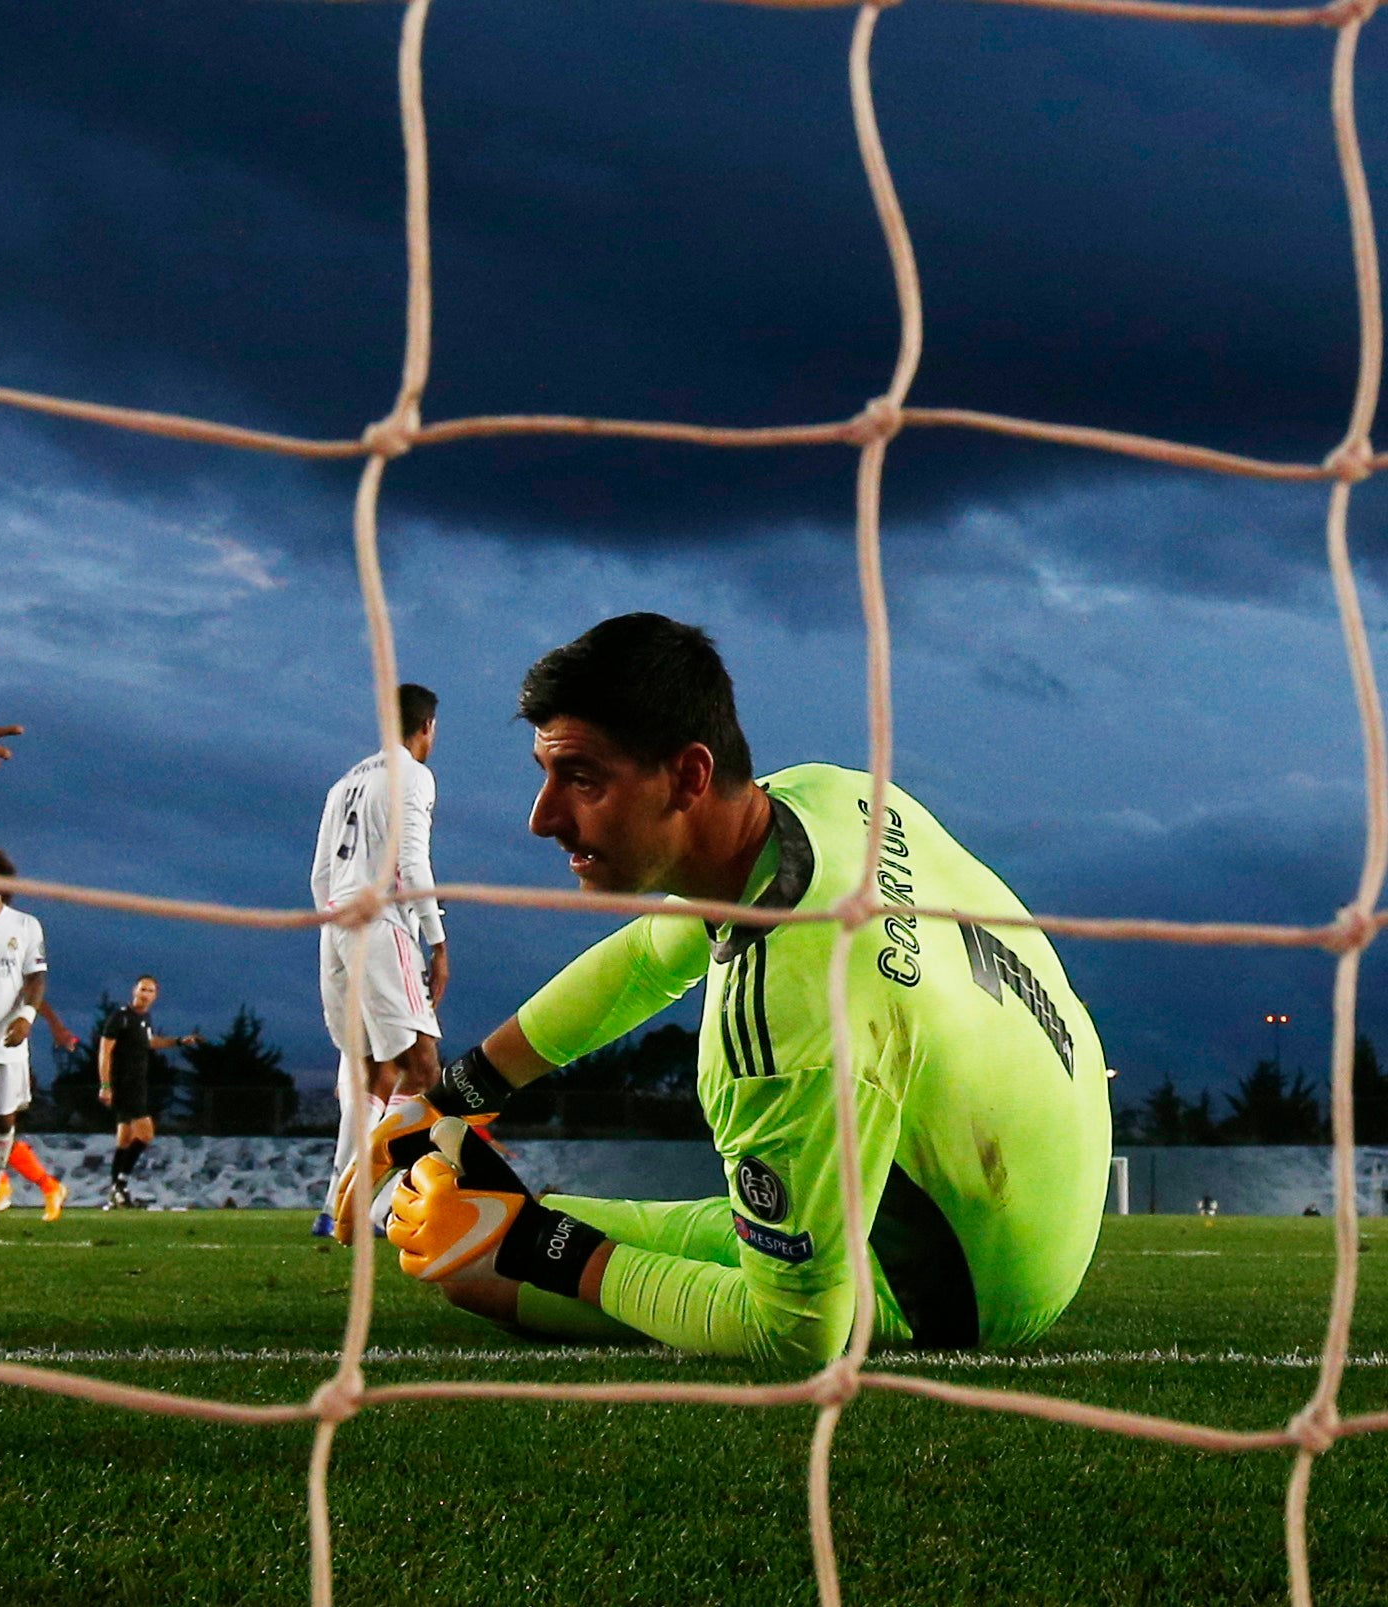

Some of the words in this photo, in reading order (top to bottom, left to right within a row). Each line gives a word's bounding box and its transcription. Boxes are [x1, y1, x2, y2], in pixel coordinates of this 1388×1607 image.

[451, 1059, 485, 1109] COURTO
[751, 1189, 773, 1208] 13
[547, 1215, 577, 1260] COURT
[749, 1229, 808, 1256] RESPECT
